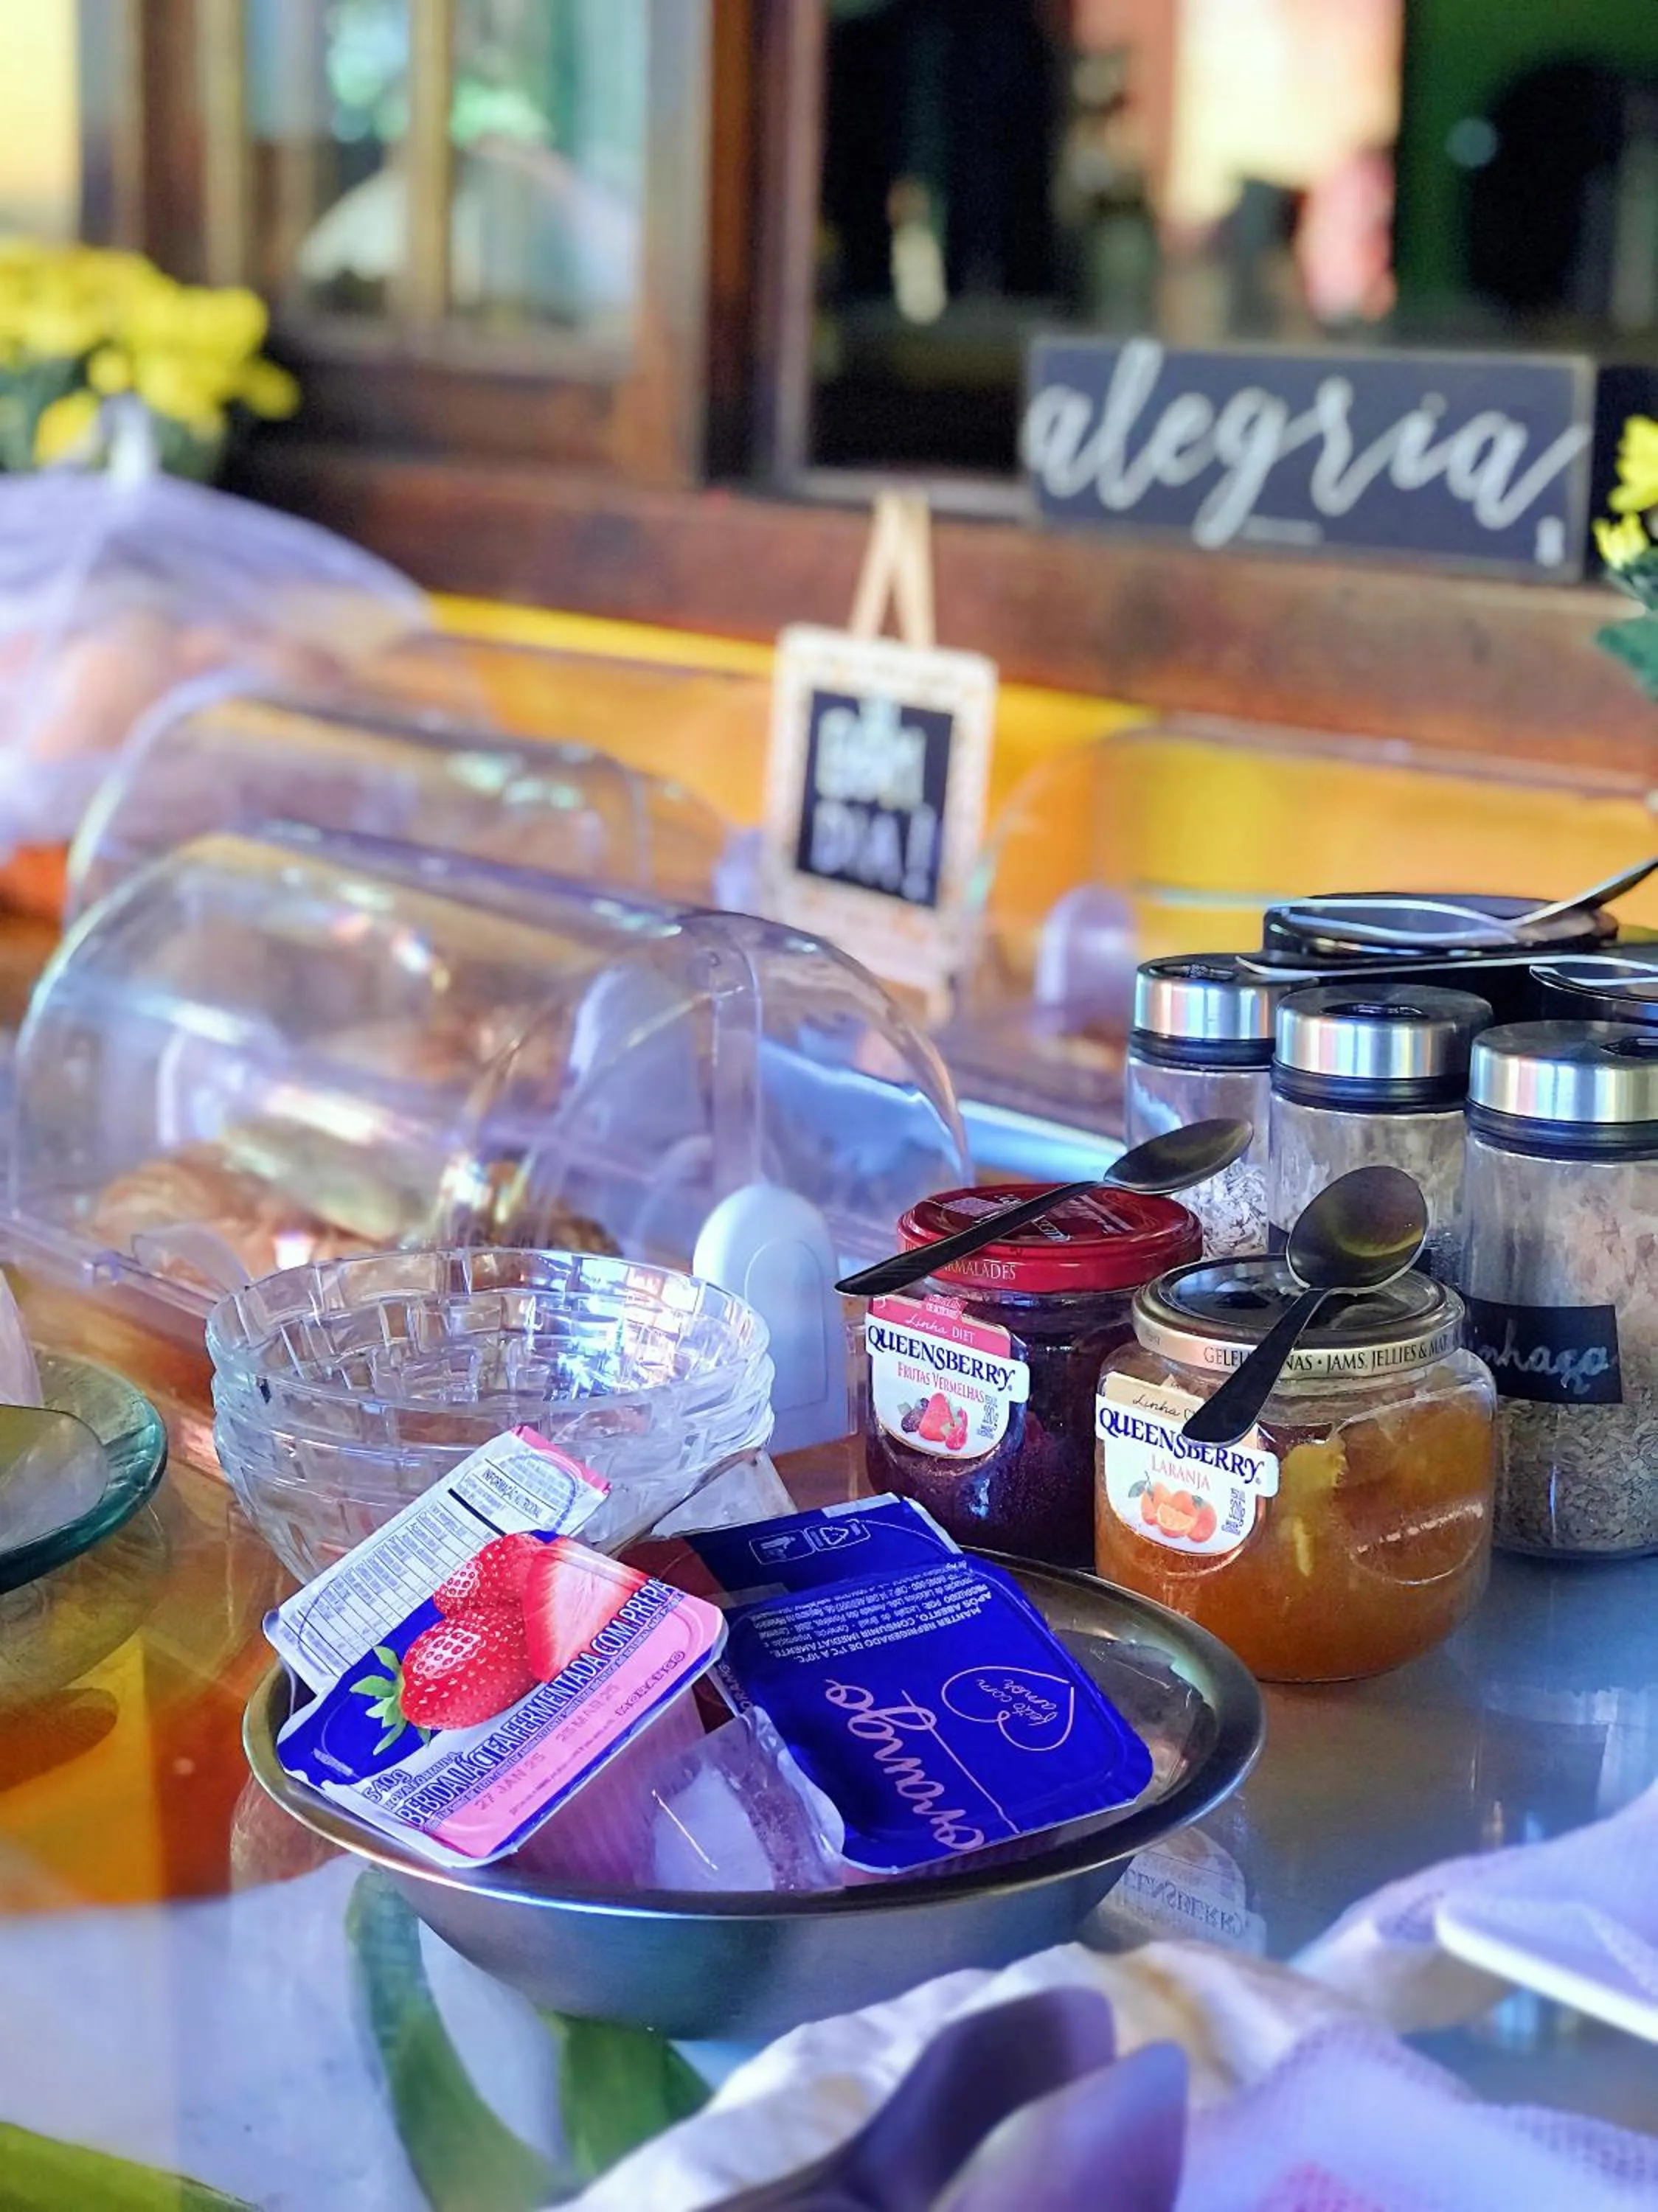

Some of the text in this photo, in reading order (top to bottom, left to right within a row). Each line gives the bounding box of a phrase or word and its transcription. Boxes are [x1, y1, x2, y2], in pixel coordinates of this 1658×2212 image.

[904, 1313, 976, 1343] Linha DIET
[868, 1325, 1016, 1392] QUEENSBERRY
[1372, 1344, 1417, 1372] JELLIES
[1418, 1342, 1427, 1359] &
[1132, 1394, 1180, 1417] Linha
[1099, 1408, 1265, 1484] QUEENSBERRY
[1151, 1454, 1211, 1492] LARANJA
[820, 1649, 829, 1658] A
[847, 1641, 863, 1652] DE
[977, 1679, 1011, 1704] com
[1004, 1680, 1055, 1710] amor
[395, 1776, 467, 1826] BEBIDA
[449, 1733, 519, 1785] LÁCTEA
[502, 1654, 608, 1740] FERMENTADA
[590, 1618, 636, 1657] COM
[495, 1767, 527, 1795] JAN
